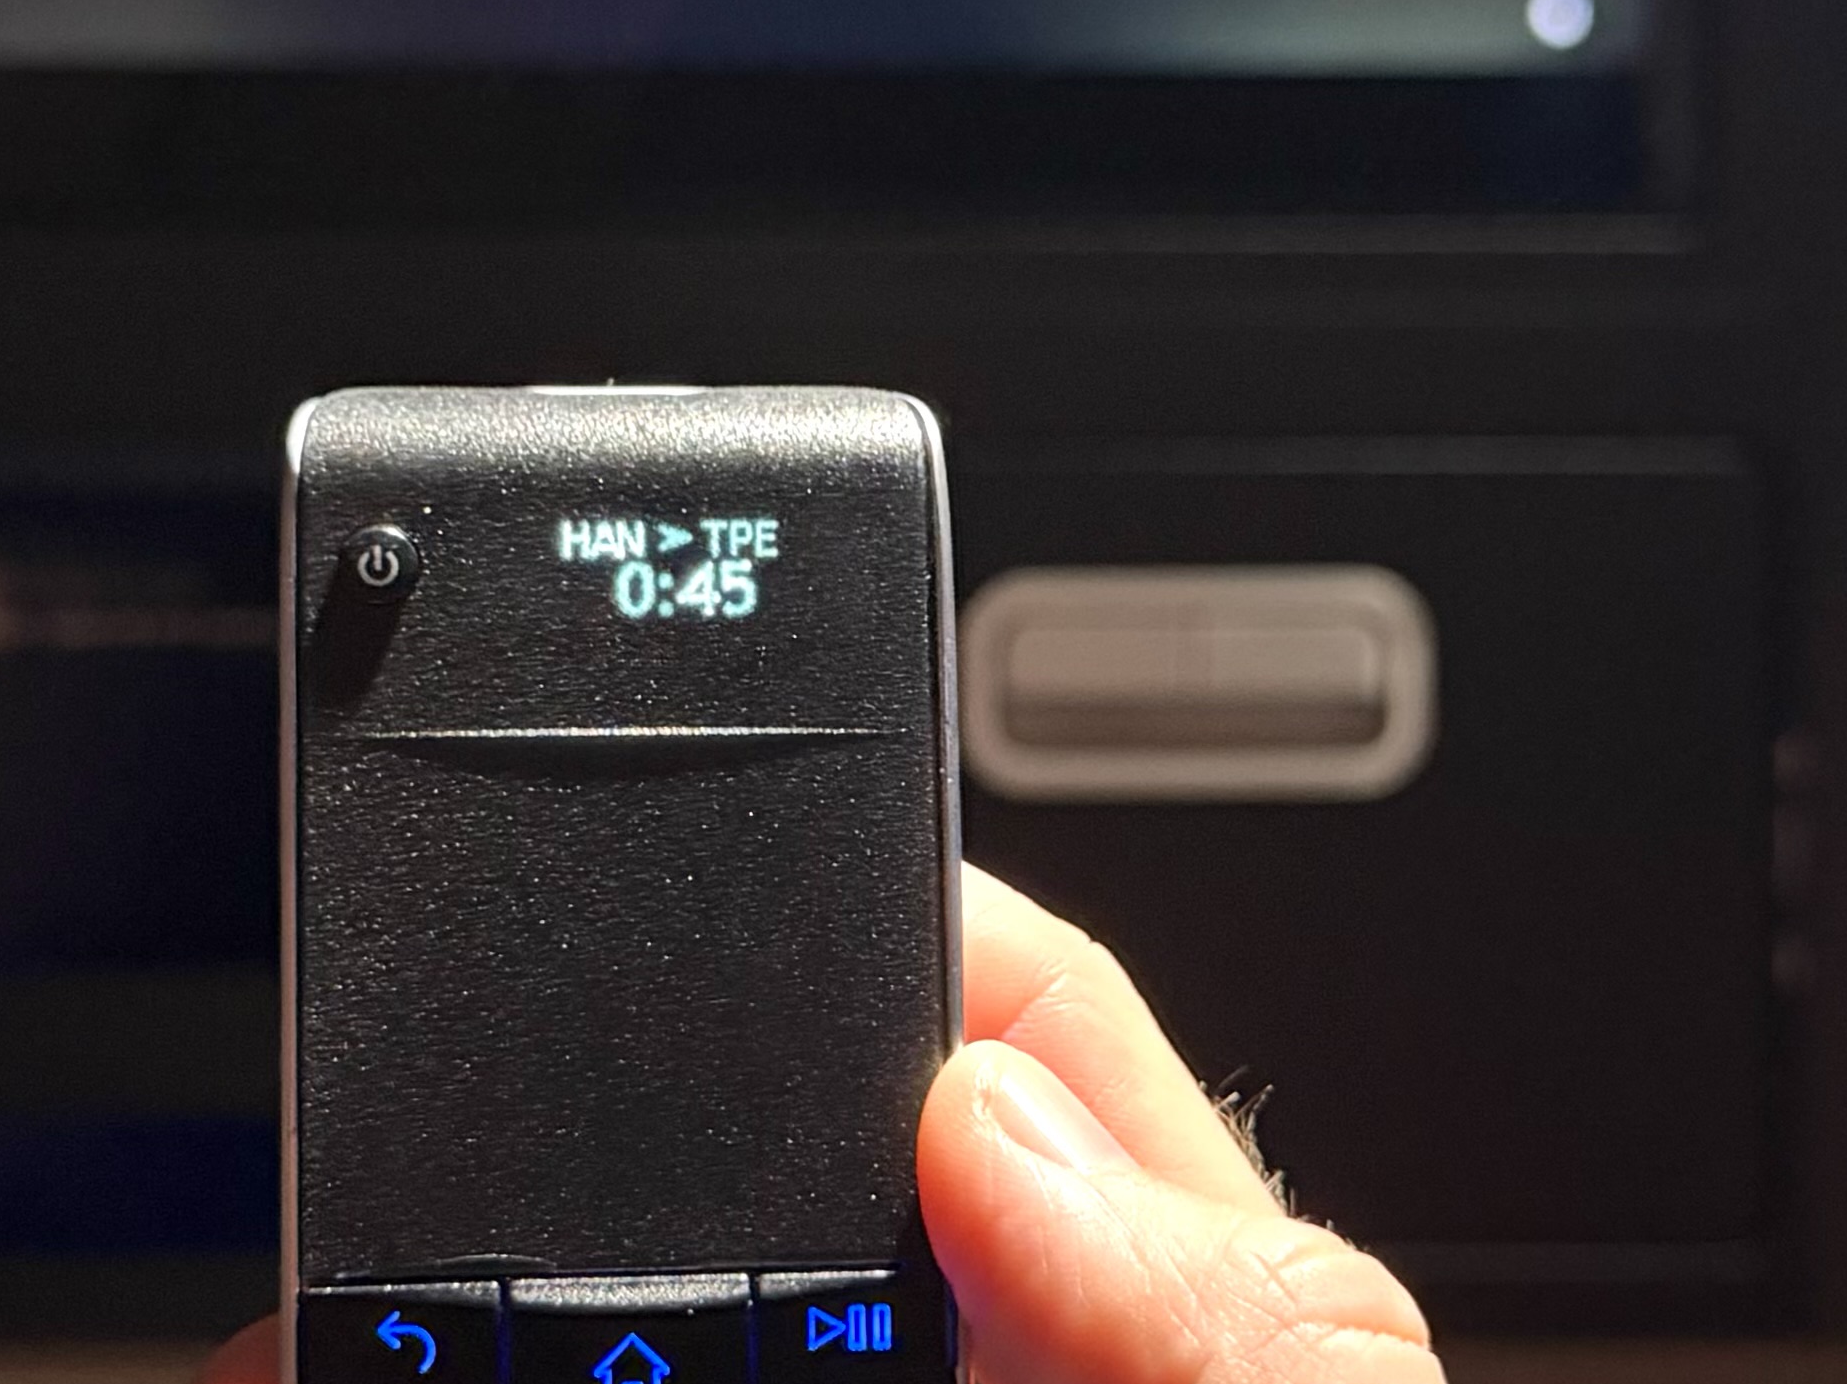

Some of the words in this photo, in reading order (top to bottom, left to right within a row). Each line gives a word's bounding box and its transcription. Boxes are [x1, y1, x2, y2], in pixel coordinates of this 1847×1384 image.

[559, 518, 646, 561] HAN
[699, 517, 779, 558] TPE
[615, 560, 757, 619] 0:45
